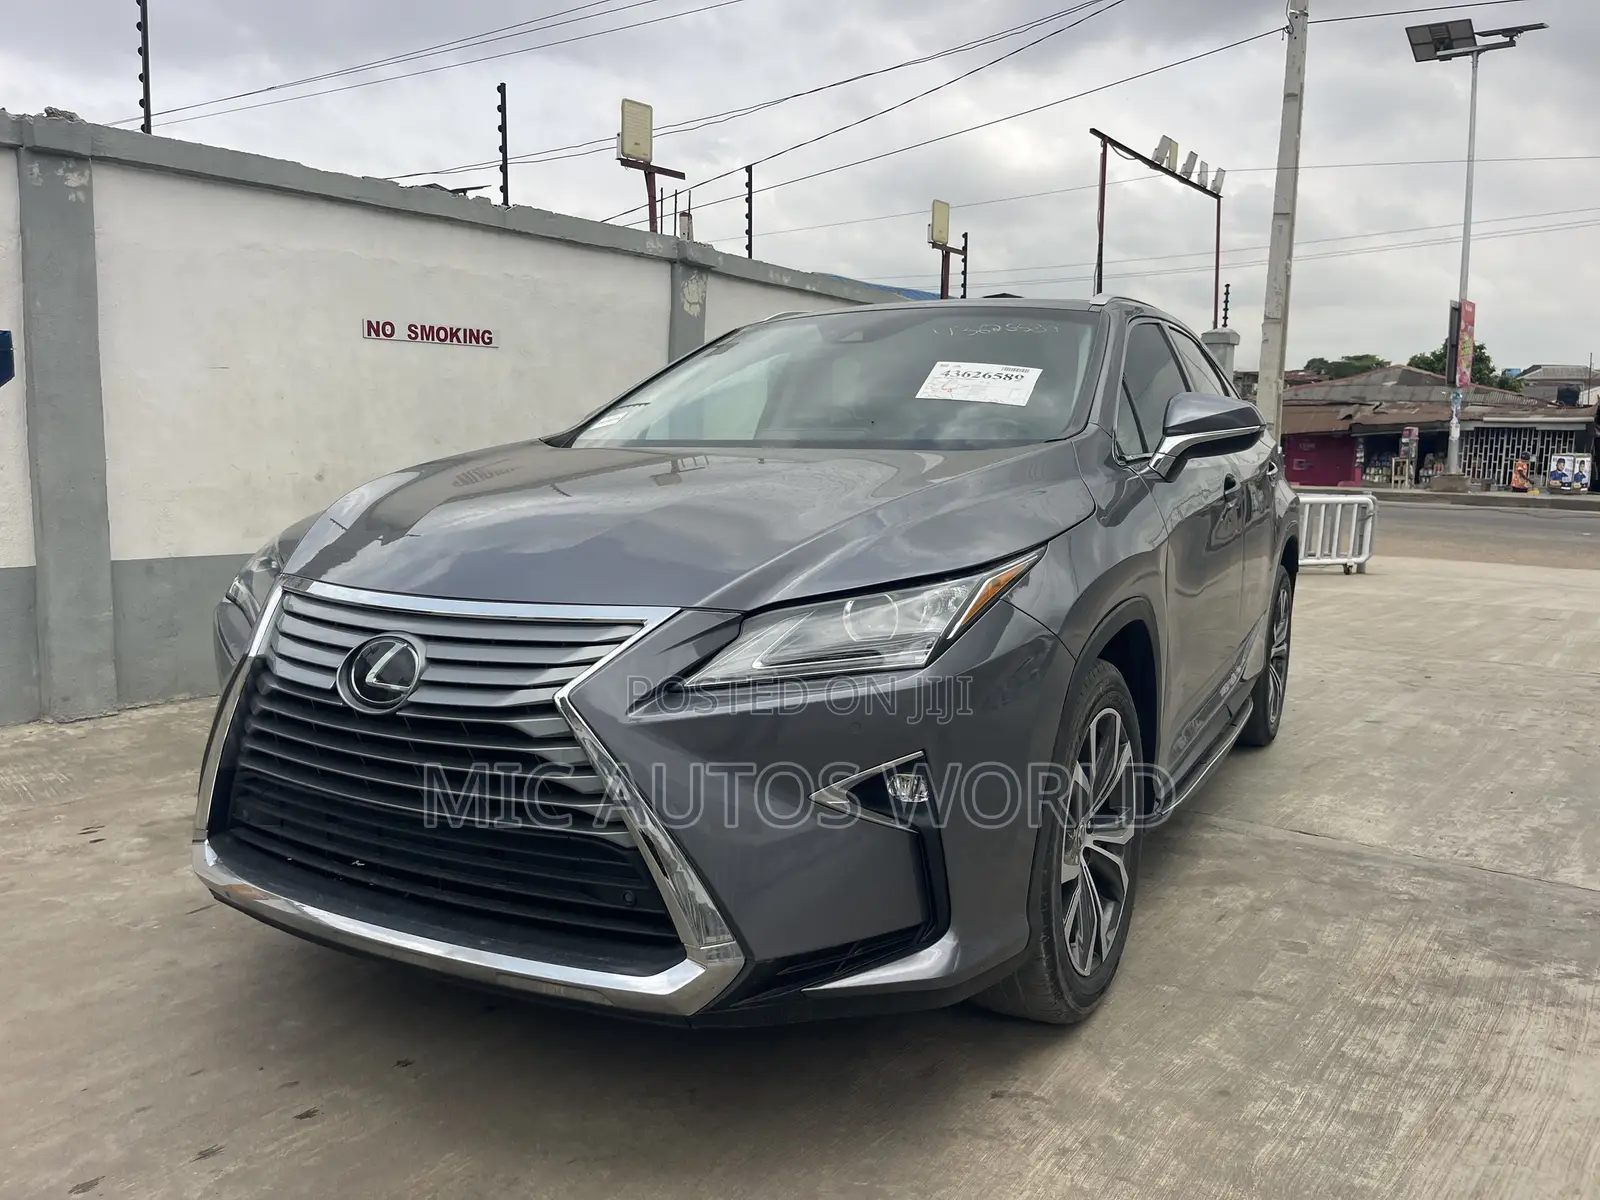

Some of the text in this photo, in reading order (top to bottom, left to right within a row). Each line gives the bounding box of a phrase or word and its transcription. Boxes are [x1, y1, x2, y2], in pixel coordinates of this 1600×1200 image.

[366, 320, 493, 345] NO SMOKING
[940, 369, 1025, 382] 43626589
